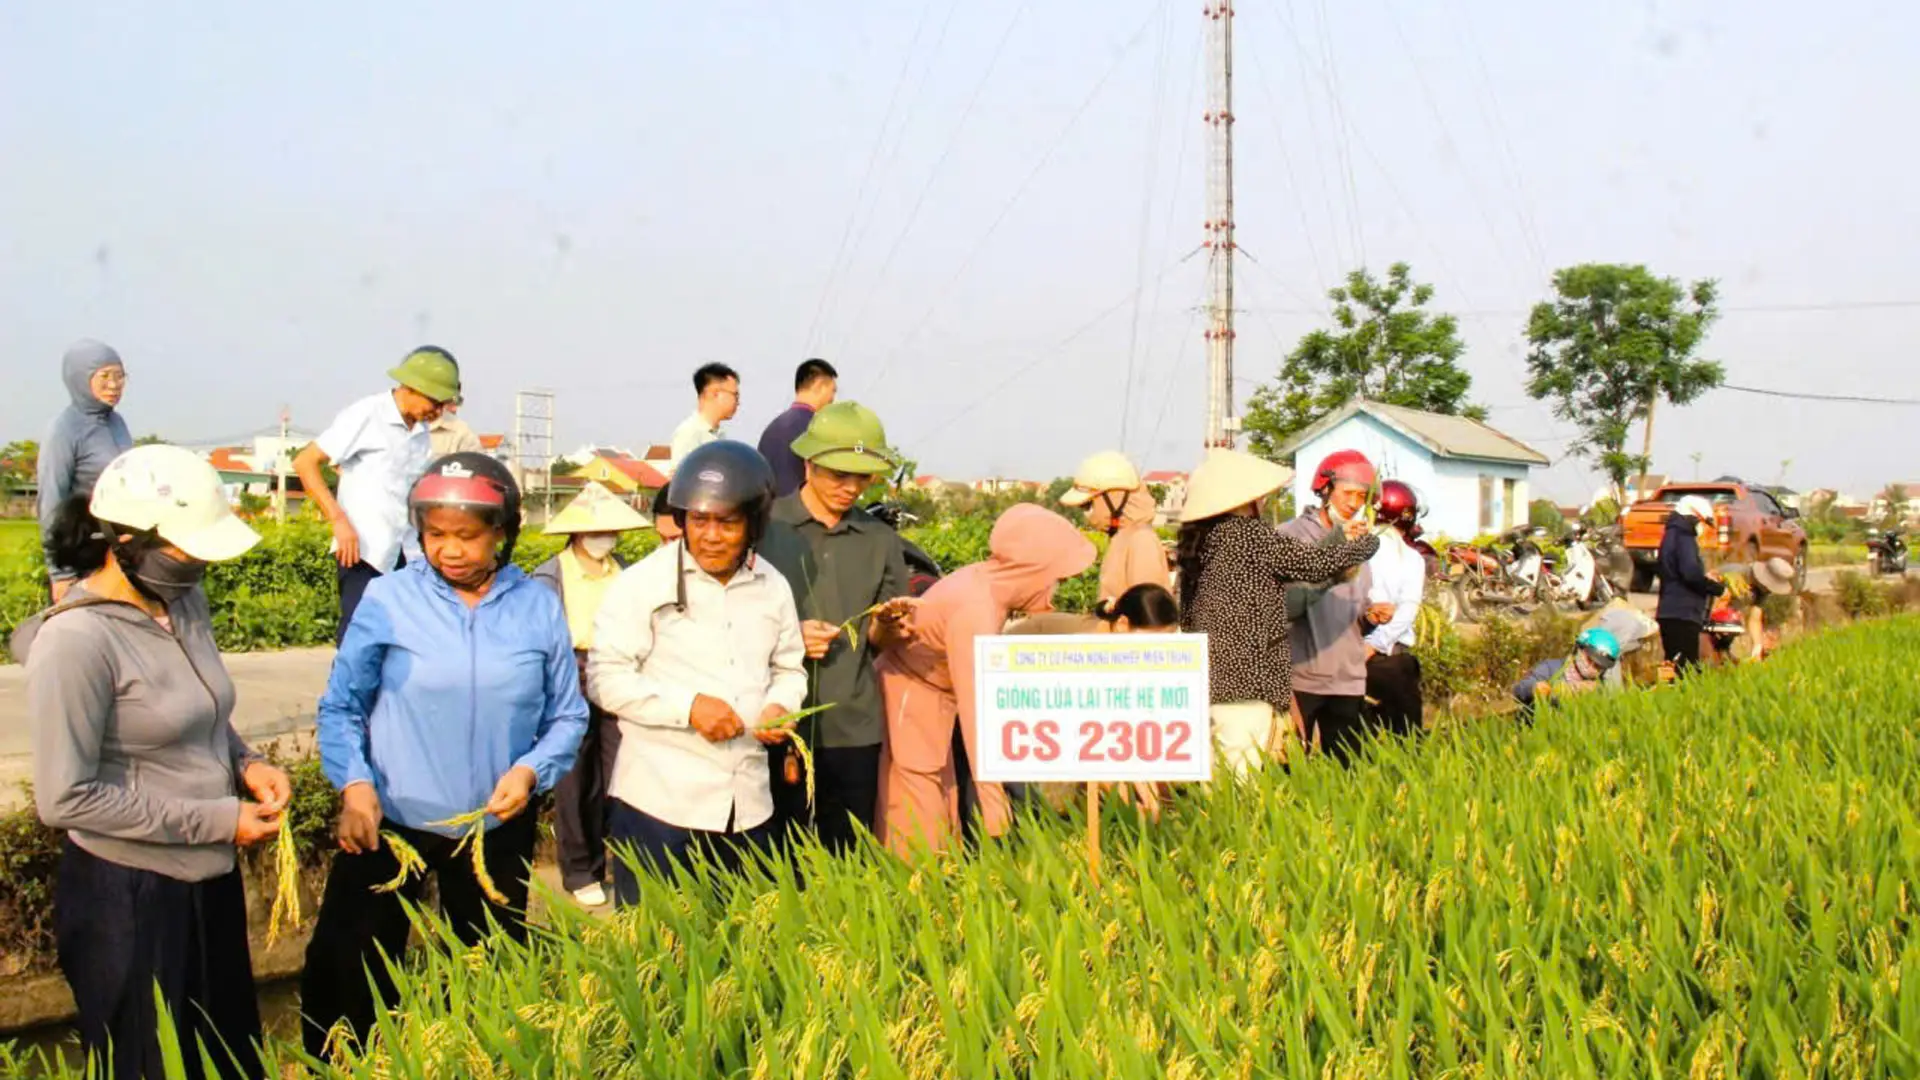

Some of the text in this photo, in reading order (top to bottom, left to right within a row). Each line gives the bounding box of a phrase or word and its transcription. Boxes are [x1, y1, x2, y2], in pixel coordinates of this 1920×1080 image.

[1078, 685, 1100, 710] LAI
[1001, 719, 1192, 762] CS 2302
